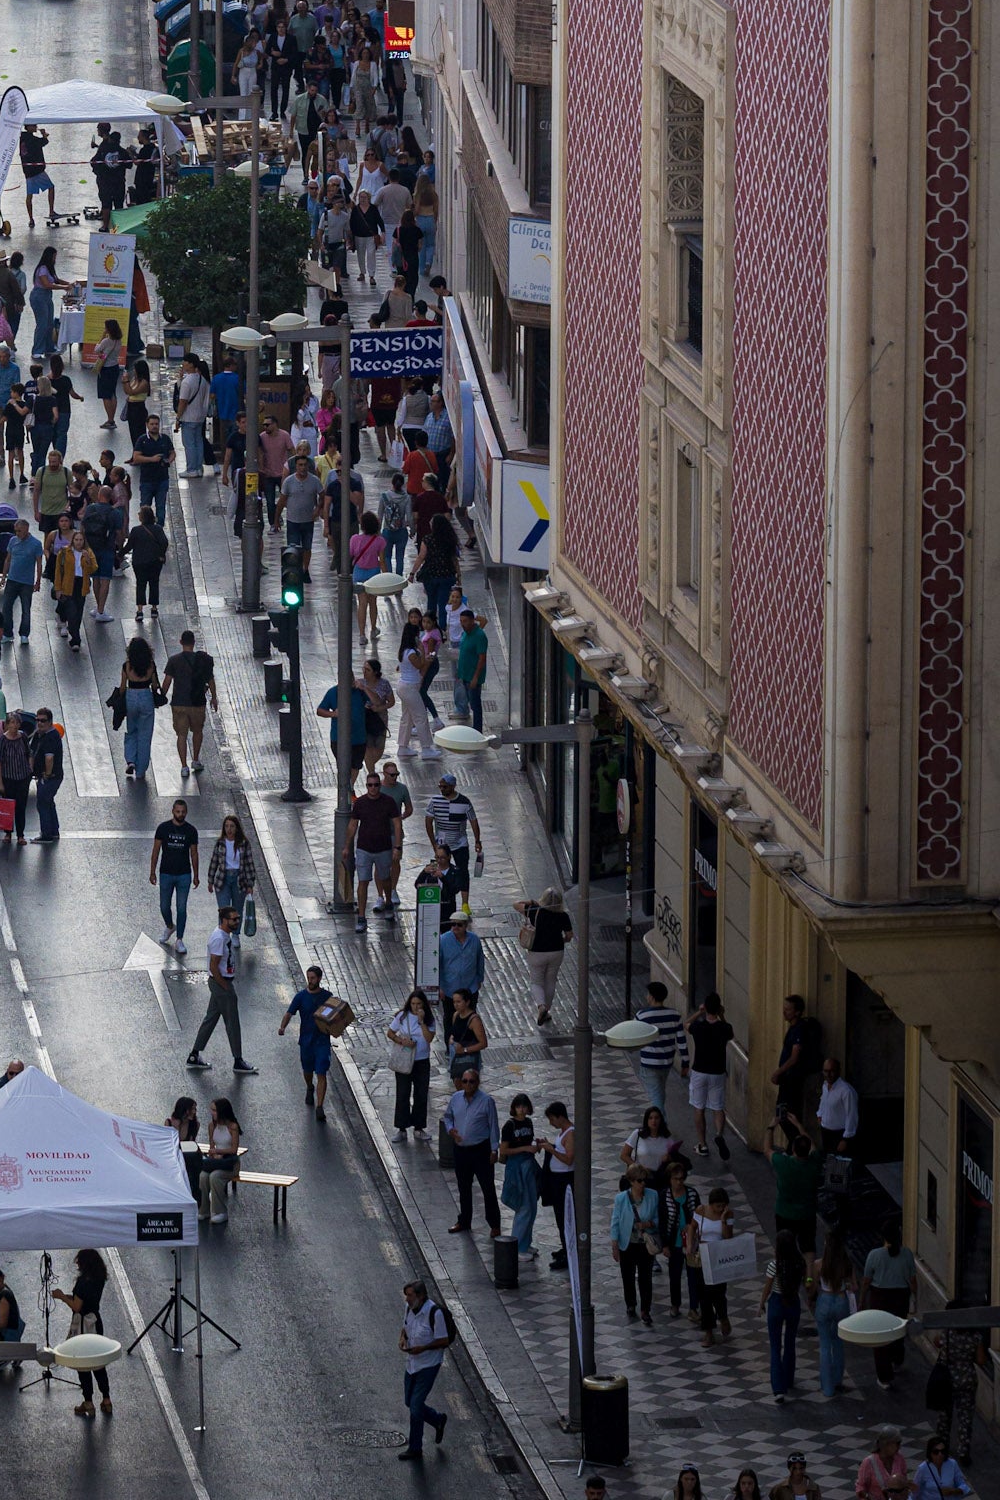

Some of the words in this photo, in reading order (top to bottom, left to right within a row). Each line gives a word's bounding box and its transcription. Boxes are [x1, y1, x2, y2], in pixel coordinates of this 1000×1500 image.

[511, 223, 551, 238] Clínica
[350, 332, 443, 353] PENSIÓN
[350, 356, 444, 374] Recogidas
[25, 1151, 91, 1160] MOVILIDAD
[146, 1218, 164, 1227] ÁREA
[718, 1254, 745, 1265] MANGO
